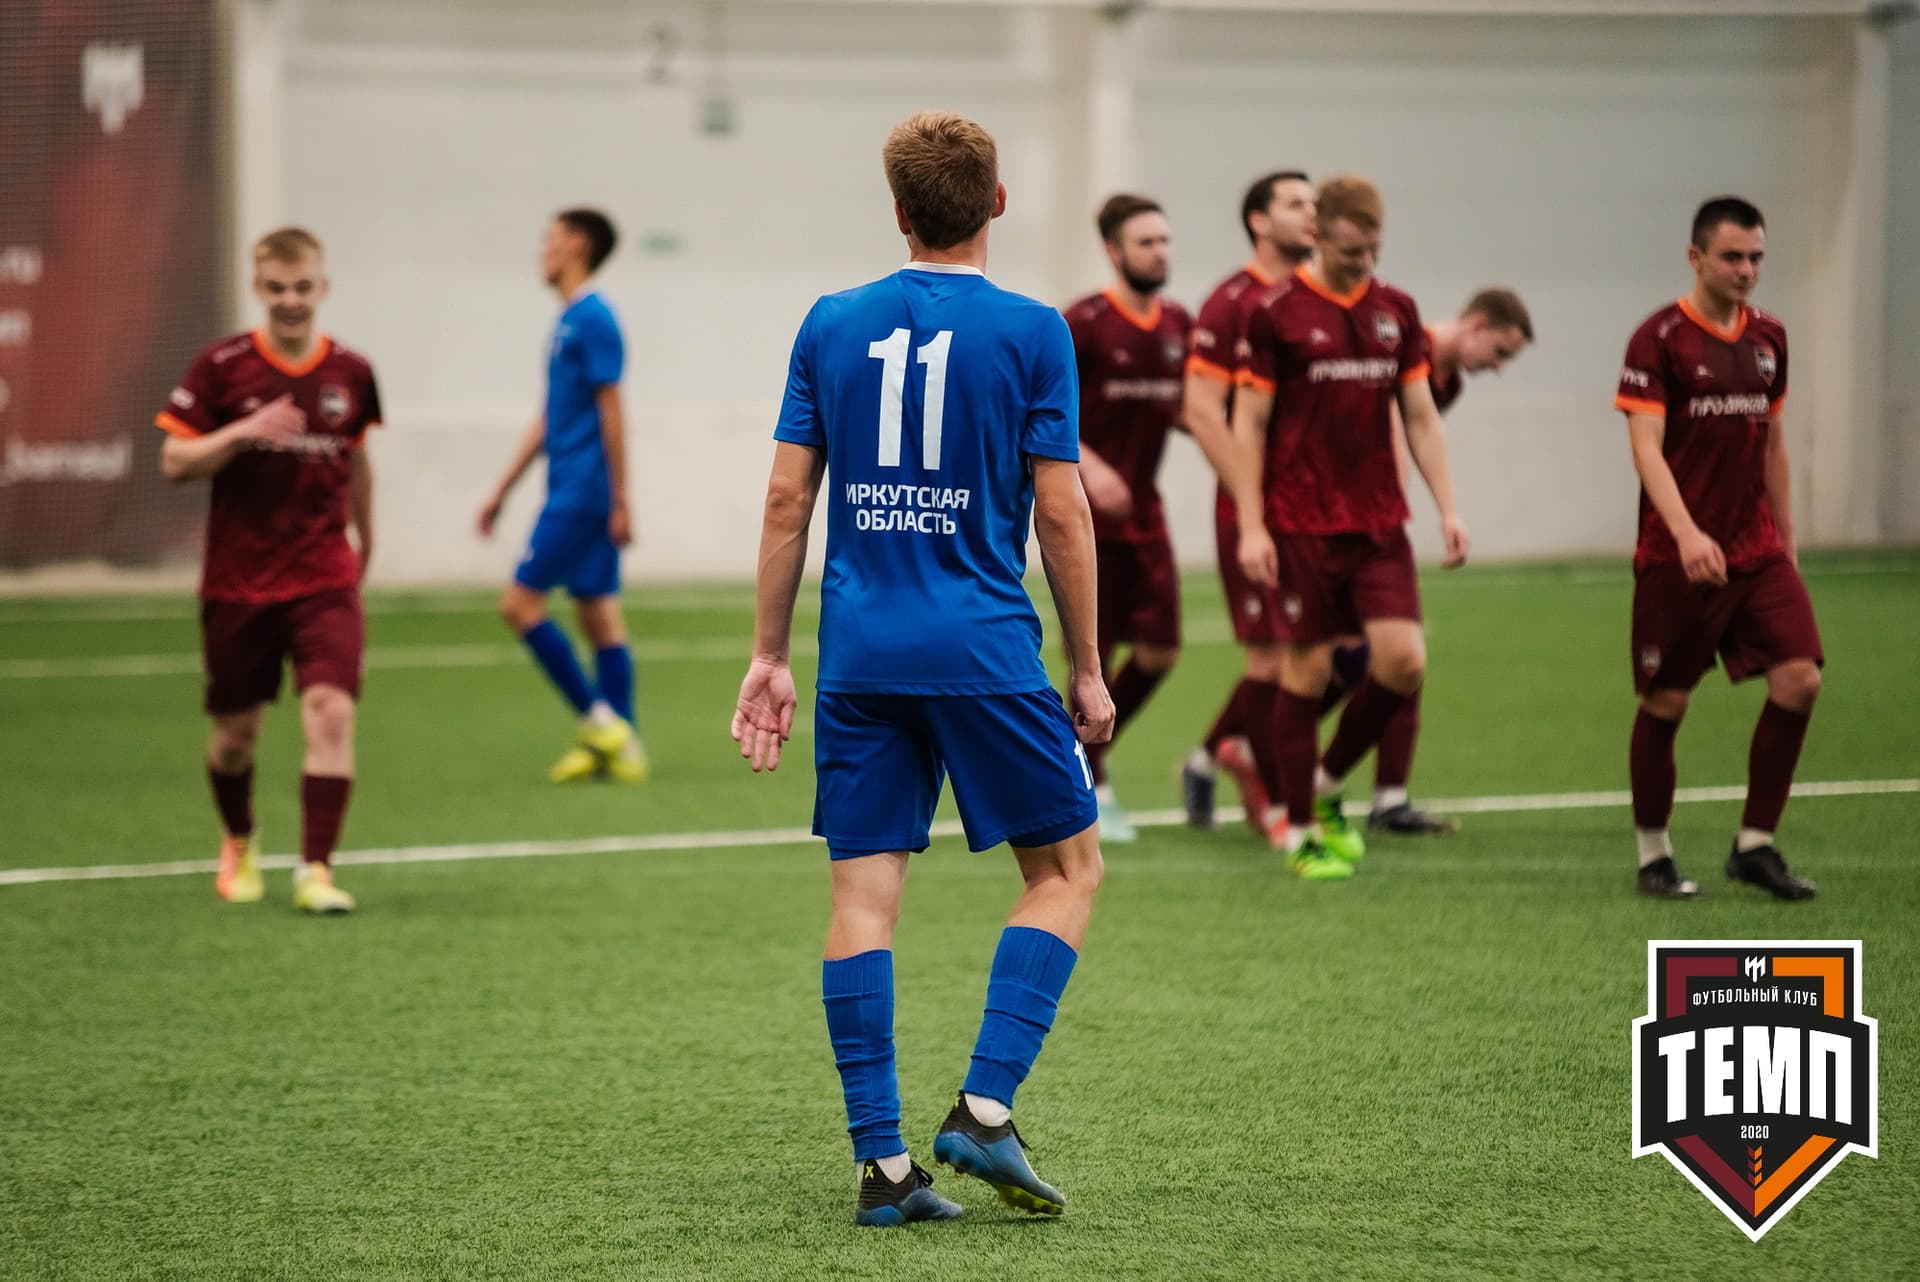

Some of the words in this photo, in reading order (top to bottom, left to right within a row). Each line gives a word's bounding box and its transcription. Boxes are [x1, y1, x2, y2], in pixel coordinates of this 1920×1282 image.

[868, 327, 953, 470] 11
[846, 483, 970, 510] ИРКУТСКАЯ
[856, 509, 957, 535] ОБЛАСТЬ
